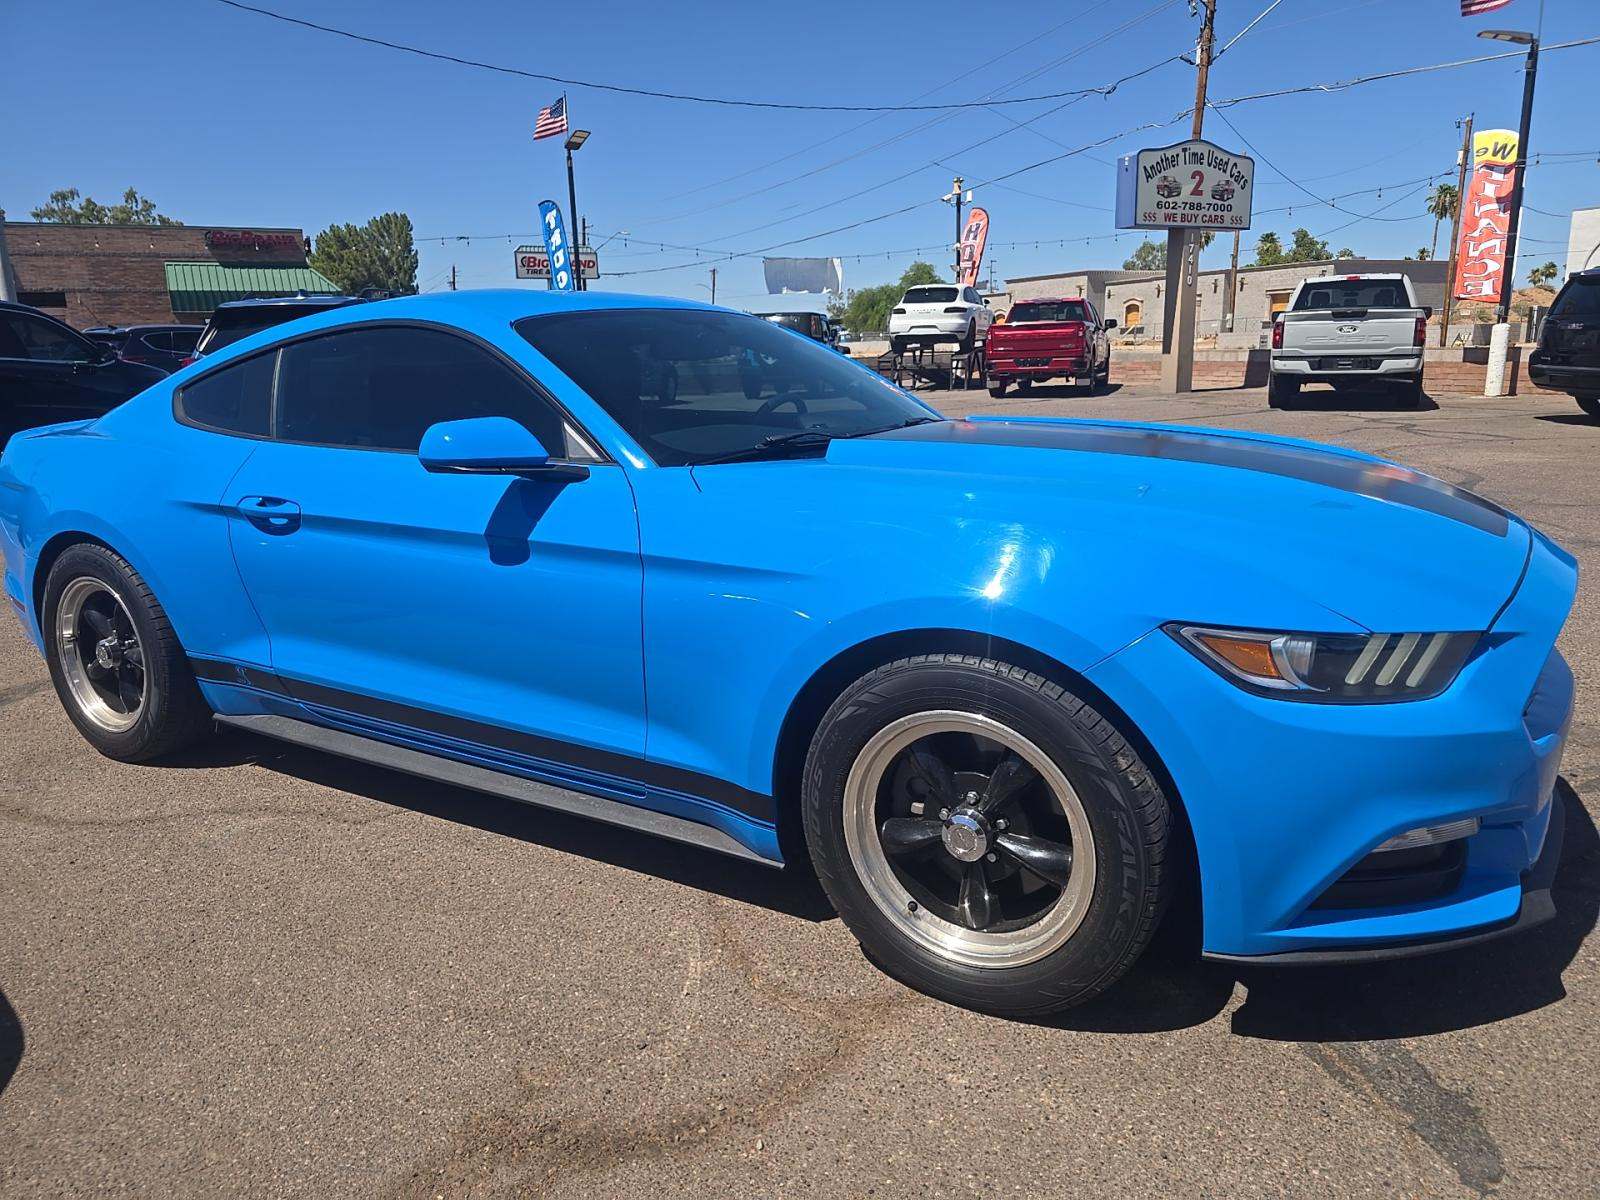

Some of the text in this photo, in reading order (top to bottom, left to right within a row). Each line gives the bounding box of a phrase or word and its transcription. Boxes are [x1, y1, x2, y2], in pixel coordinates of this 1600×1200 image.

[1143, 147, 1248, 190] Another Time Used Cars
[1189, 170, 1205, 196] 2
[1156, 200, 1233, 212] 602-788-7000
[1163, 212, 1178, 222] WE
[1180, 213, 1200, 223] BUY
[1201, 214, 1224, 224] CARS
